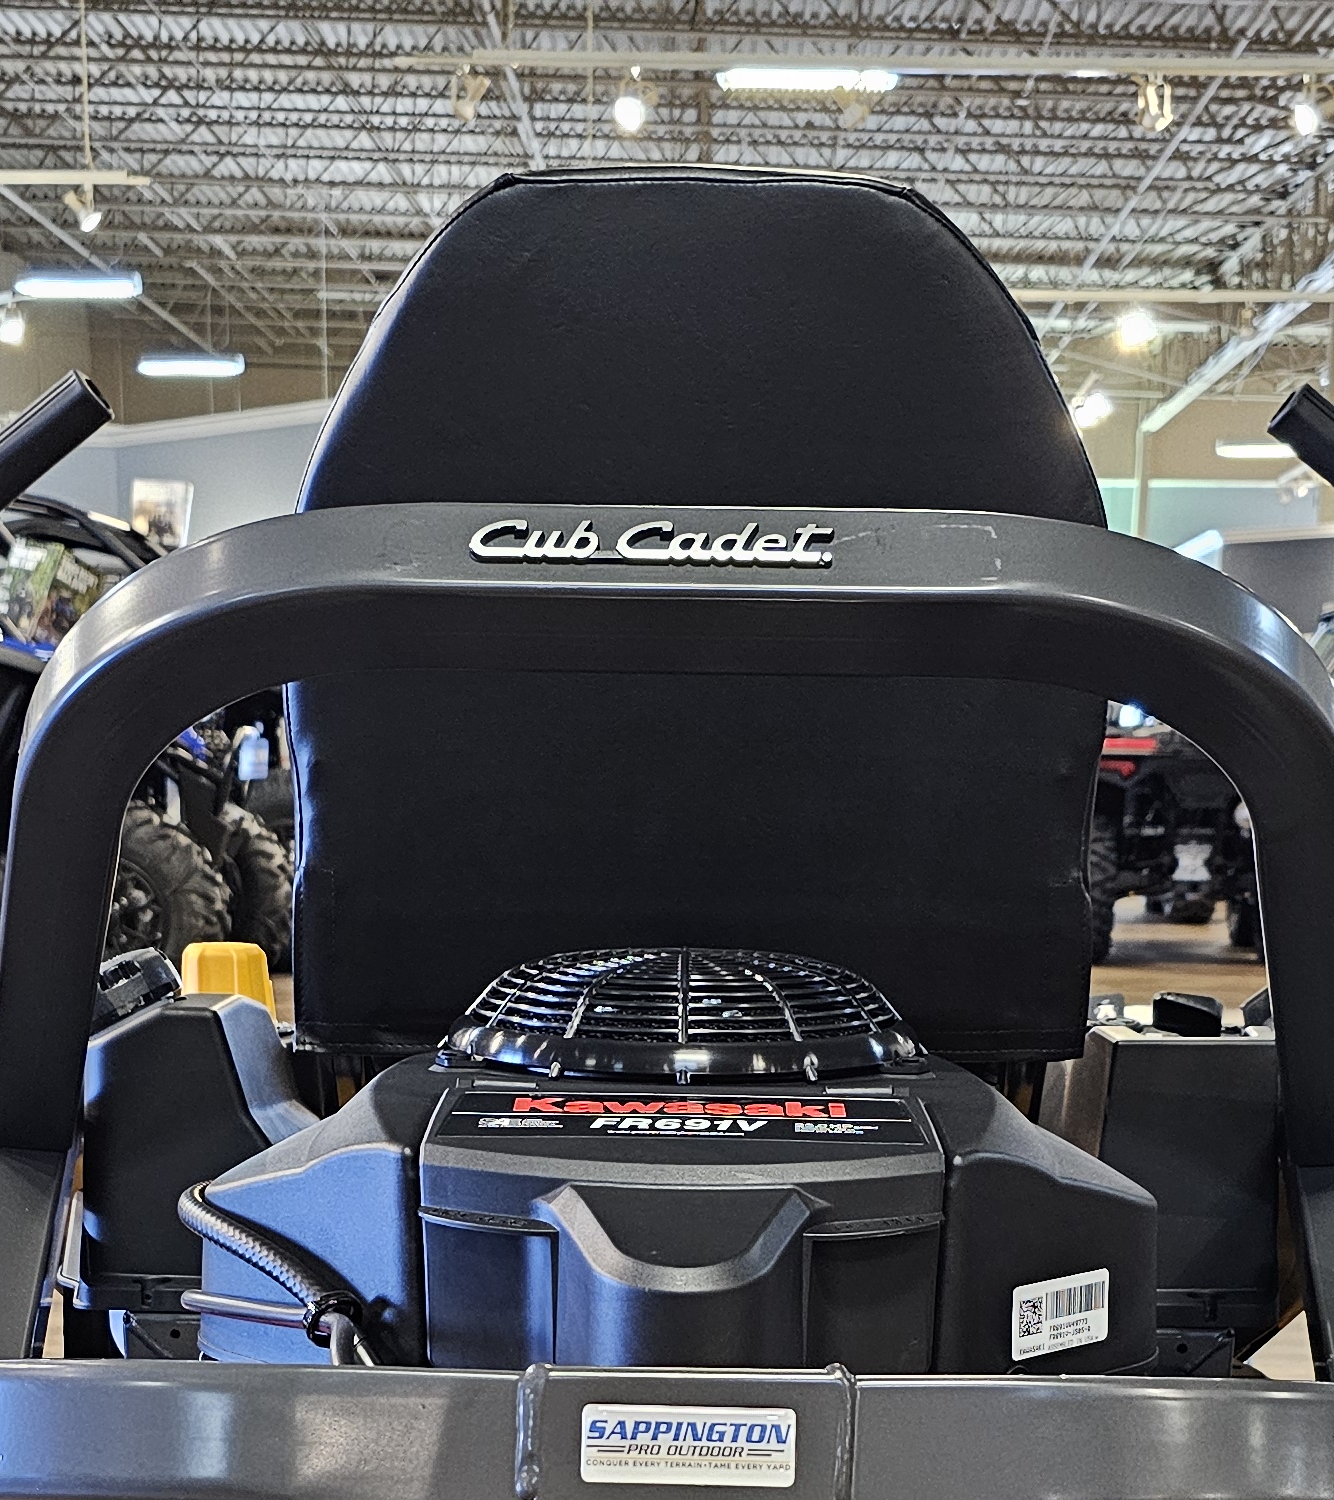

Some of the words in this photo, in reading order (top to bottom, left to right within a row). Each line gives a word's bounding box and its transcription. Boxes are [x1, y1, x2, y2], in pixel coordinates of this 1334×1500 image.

[469, 519, 601, 563] Cub
[512, 1097, 847, 1118] Kawasaki
[589, 1117, 768, 1132] FR691V
[586, 1419, 791, 1444] SAPPINGTON
[626, 1443, 661, 1456] PRO
[666, 1444, 745, 1458] OUTDOOR
[586, 1458, 629, 1467] CONQUER
[632, 1460, 661, 1468] EVERY
[767, 1463, 791, 1471] YARD
